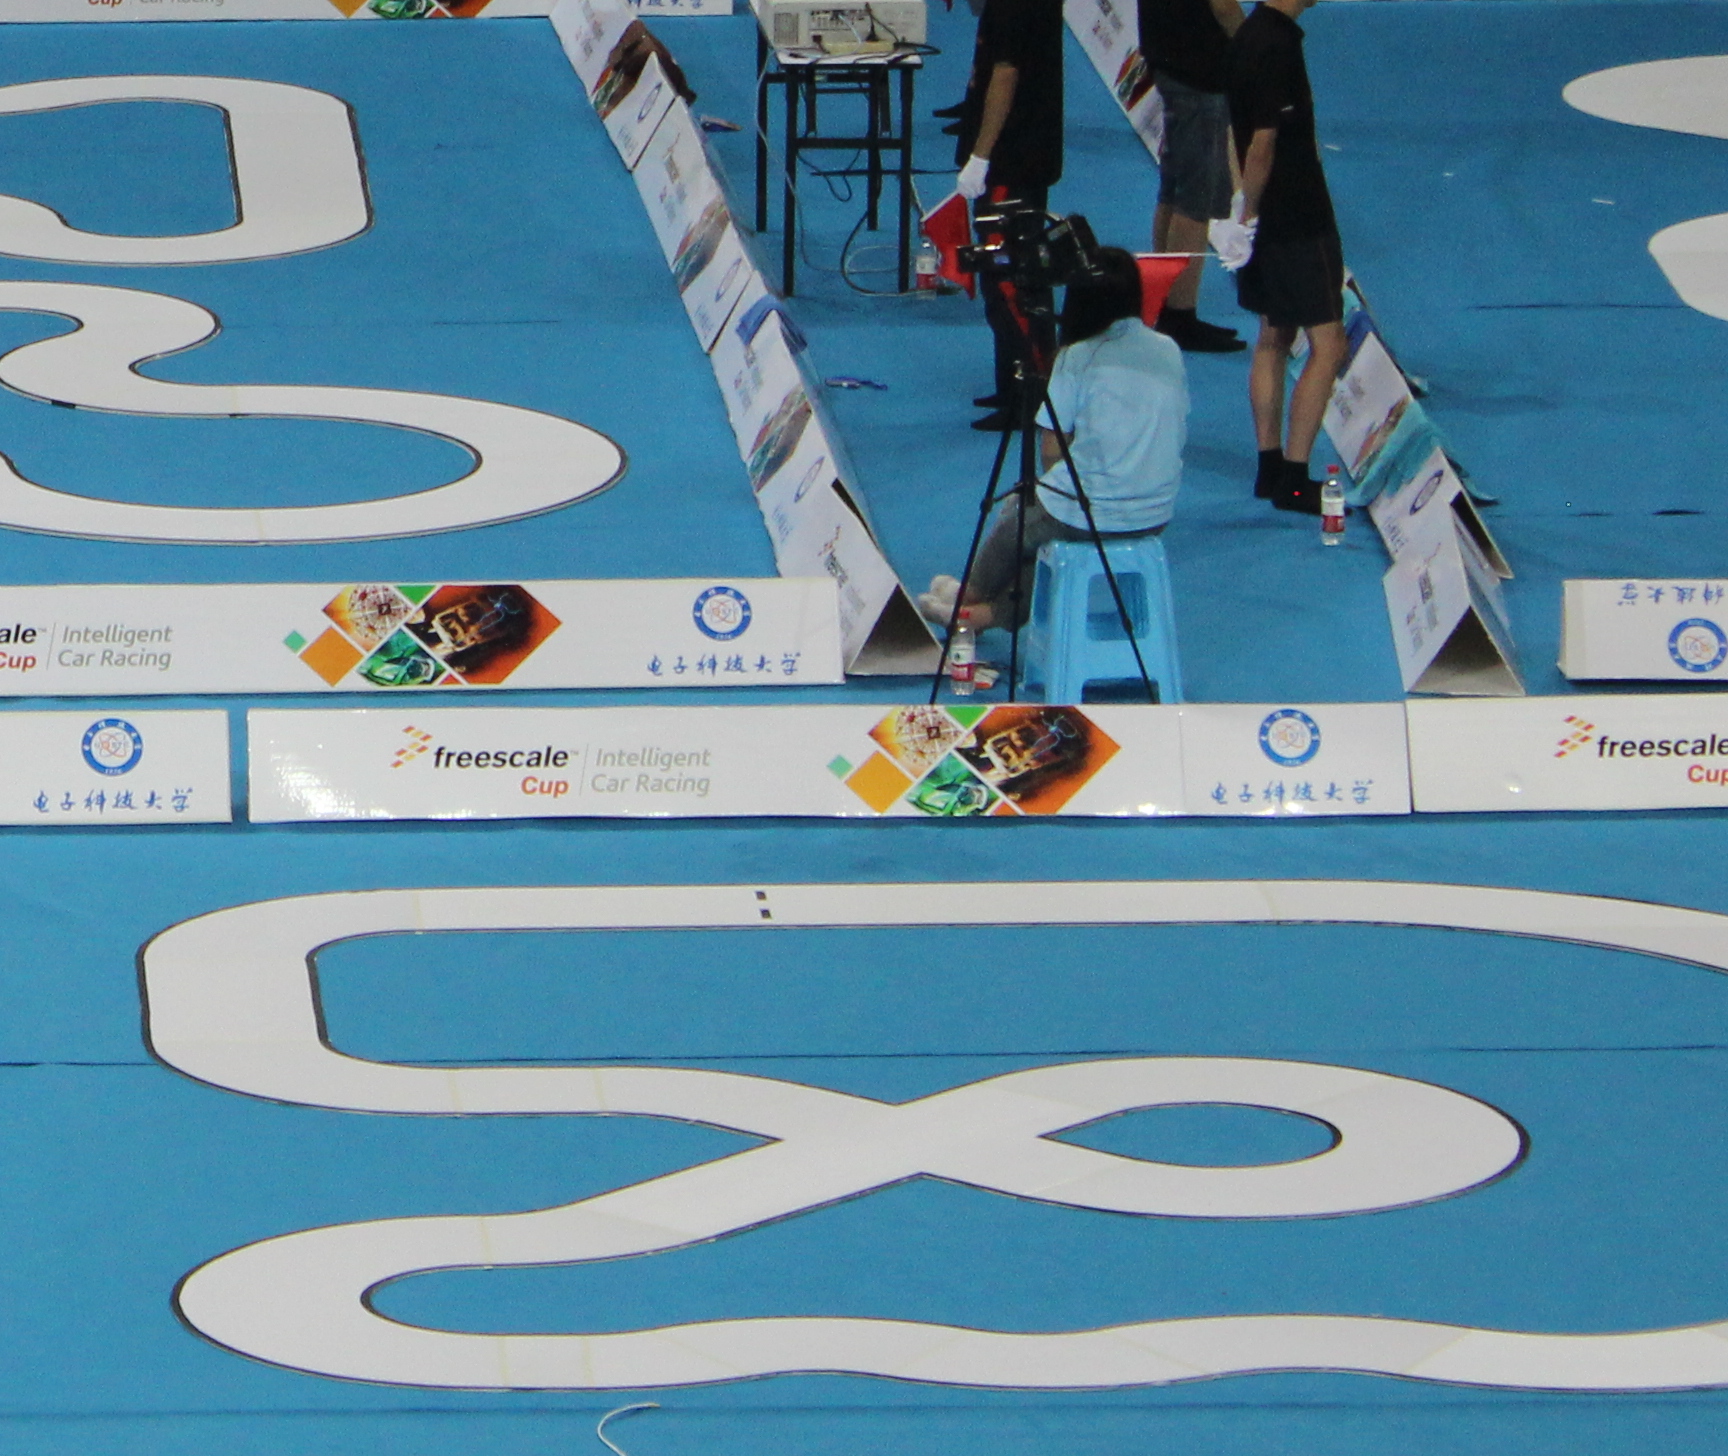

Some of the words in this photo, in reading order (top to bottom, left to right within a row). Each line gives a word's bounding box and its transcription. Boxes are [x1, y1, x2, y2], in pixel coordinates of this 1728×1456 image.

[62, 624, 173, 649] Intelligent
[57, 649, 97, 669] Car
[101, 647, 173, 672] Racing
[645, 652, 802, 678] 电子科技大学
[432, 743, 569, 770] freescale
[595, 745, 711, 773] Intelligent
[521, 774, 569, 799] Cup
[591, 774, 630, 794] Car
[635, 772, 711, 798] Racing
[1210, 778, 1375, 806] 电子科技大学
[31, 786, 193, 814] 电子科技大学
